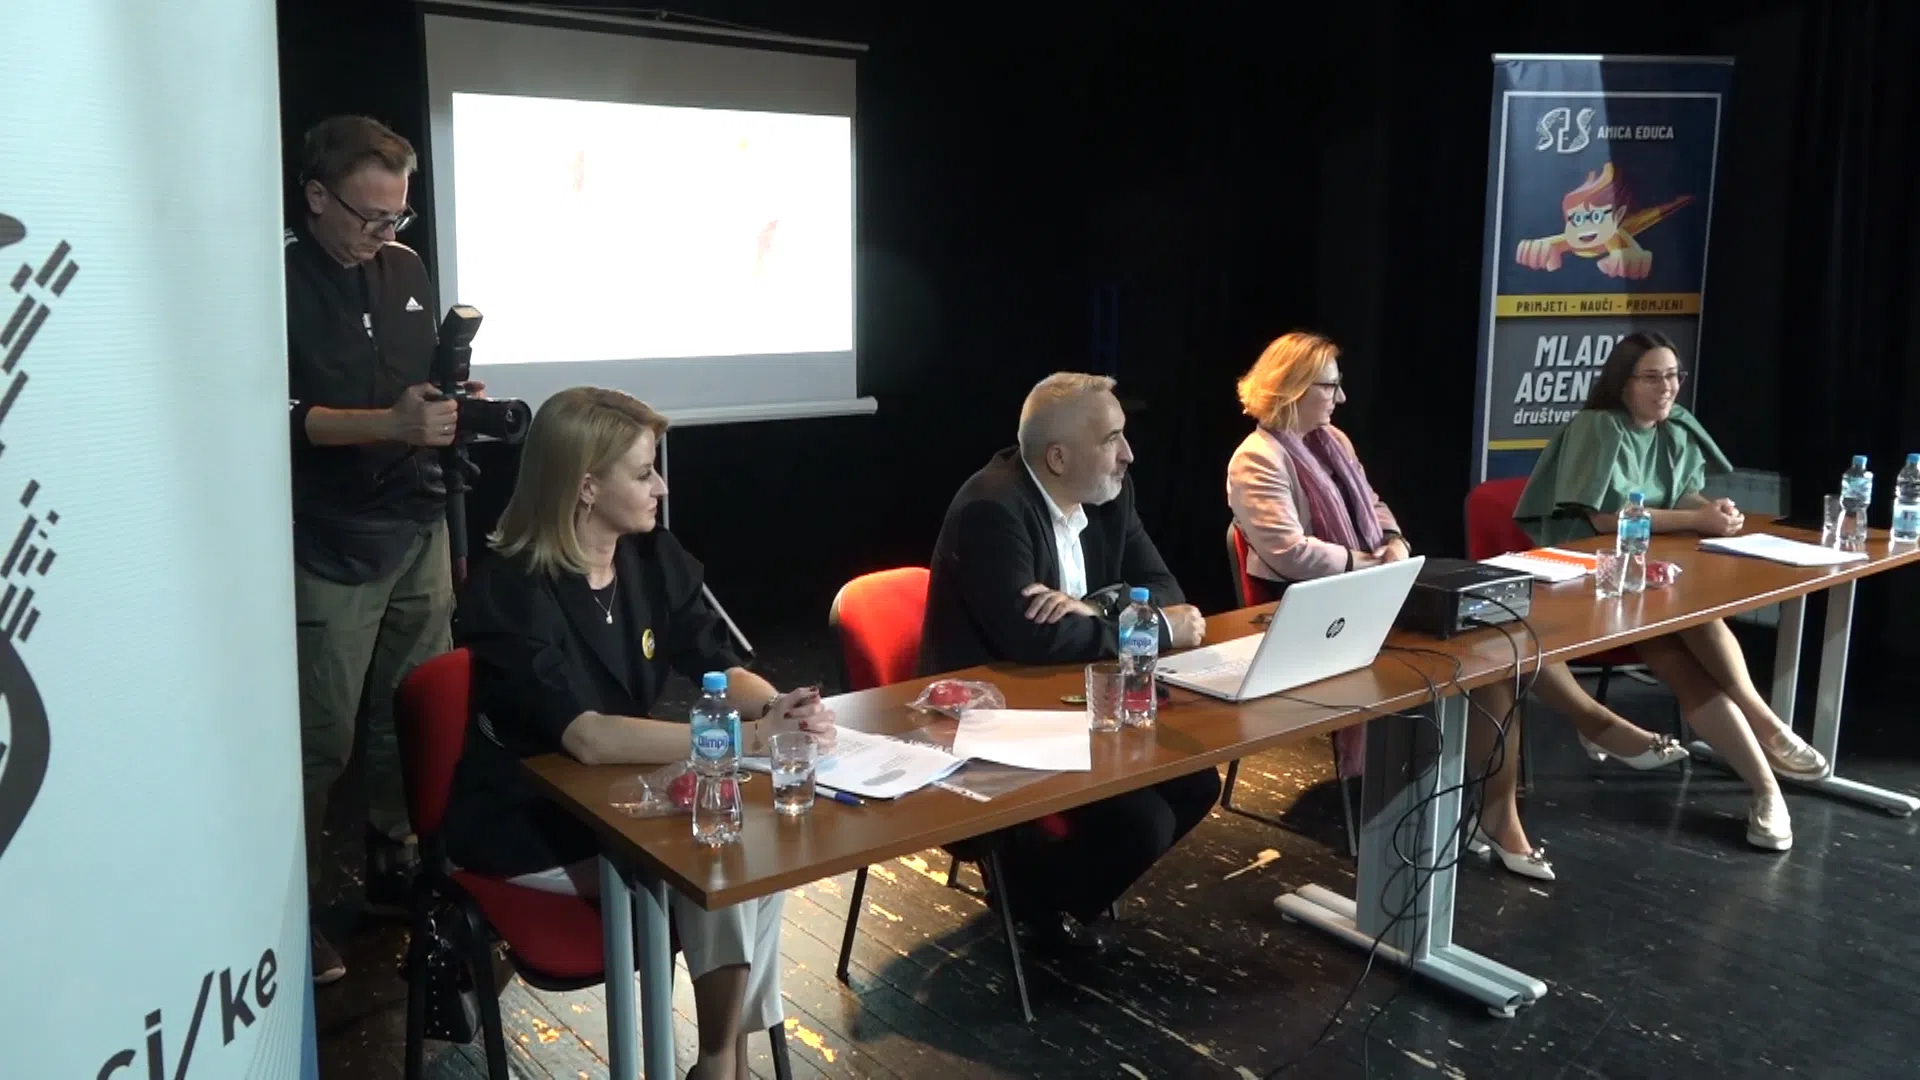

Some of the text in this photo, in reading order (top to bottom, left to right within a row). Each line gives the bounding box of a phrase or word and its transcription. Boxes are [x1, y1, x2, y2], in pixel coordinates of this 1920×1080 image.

[1597, 125, 1674, 139] AMICA EDUCA
[1516, 300, 1568, 312] PRIMJETI
[1580, 297, 1613, 311] NAUČI
[1626, 299, 1684, 311] PROMJENI
[1534, 335, 1624, 367] MLAD
[1514, 370, 1602, 402] AGEN
